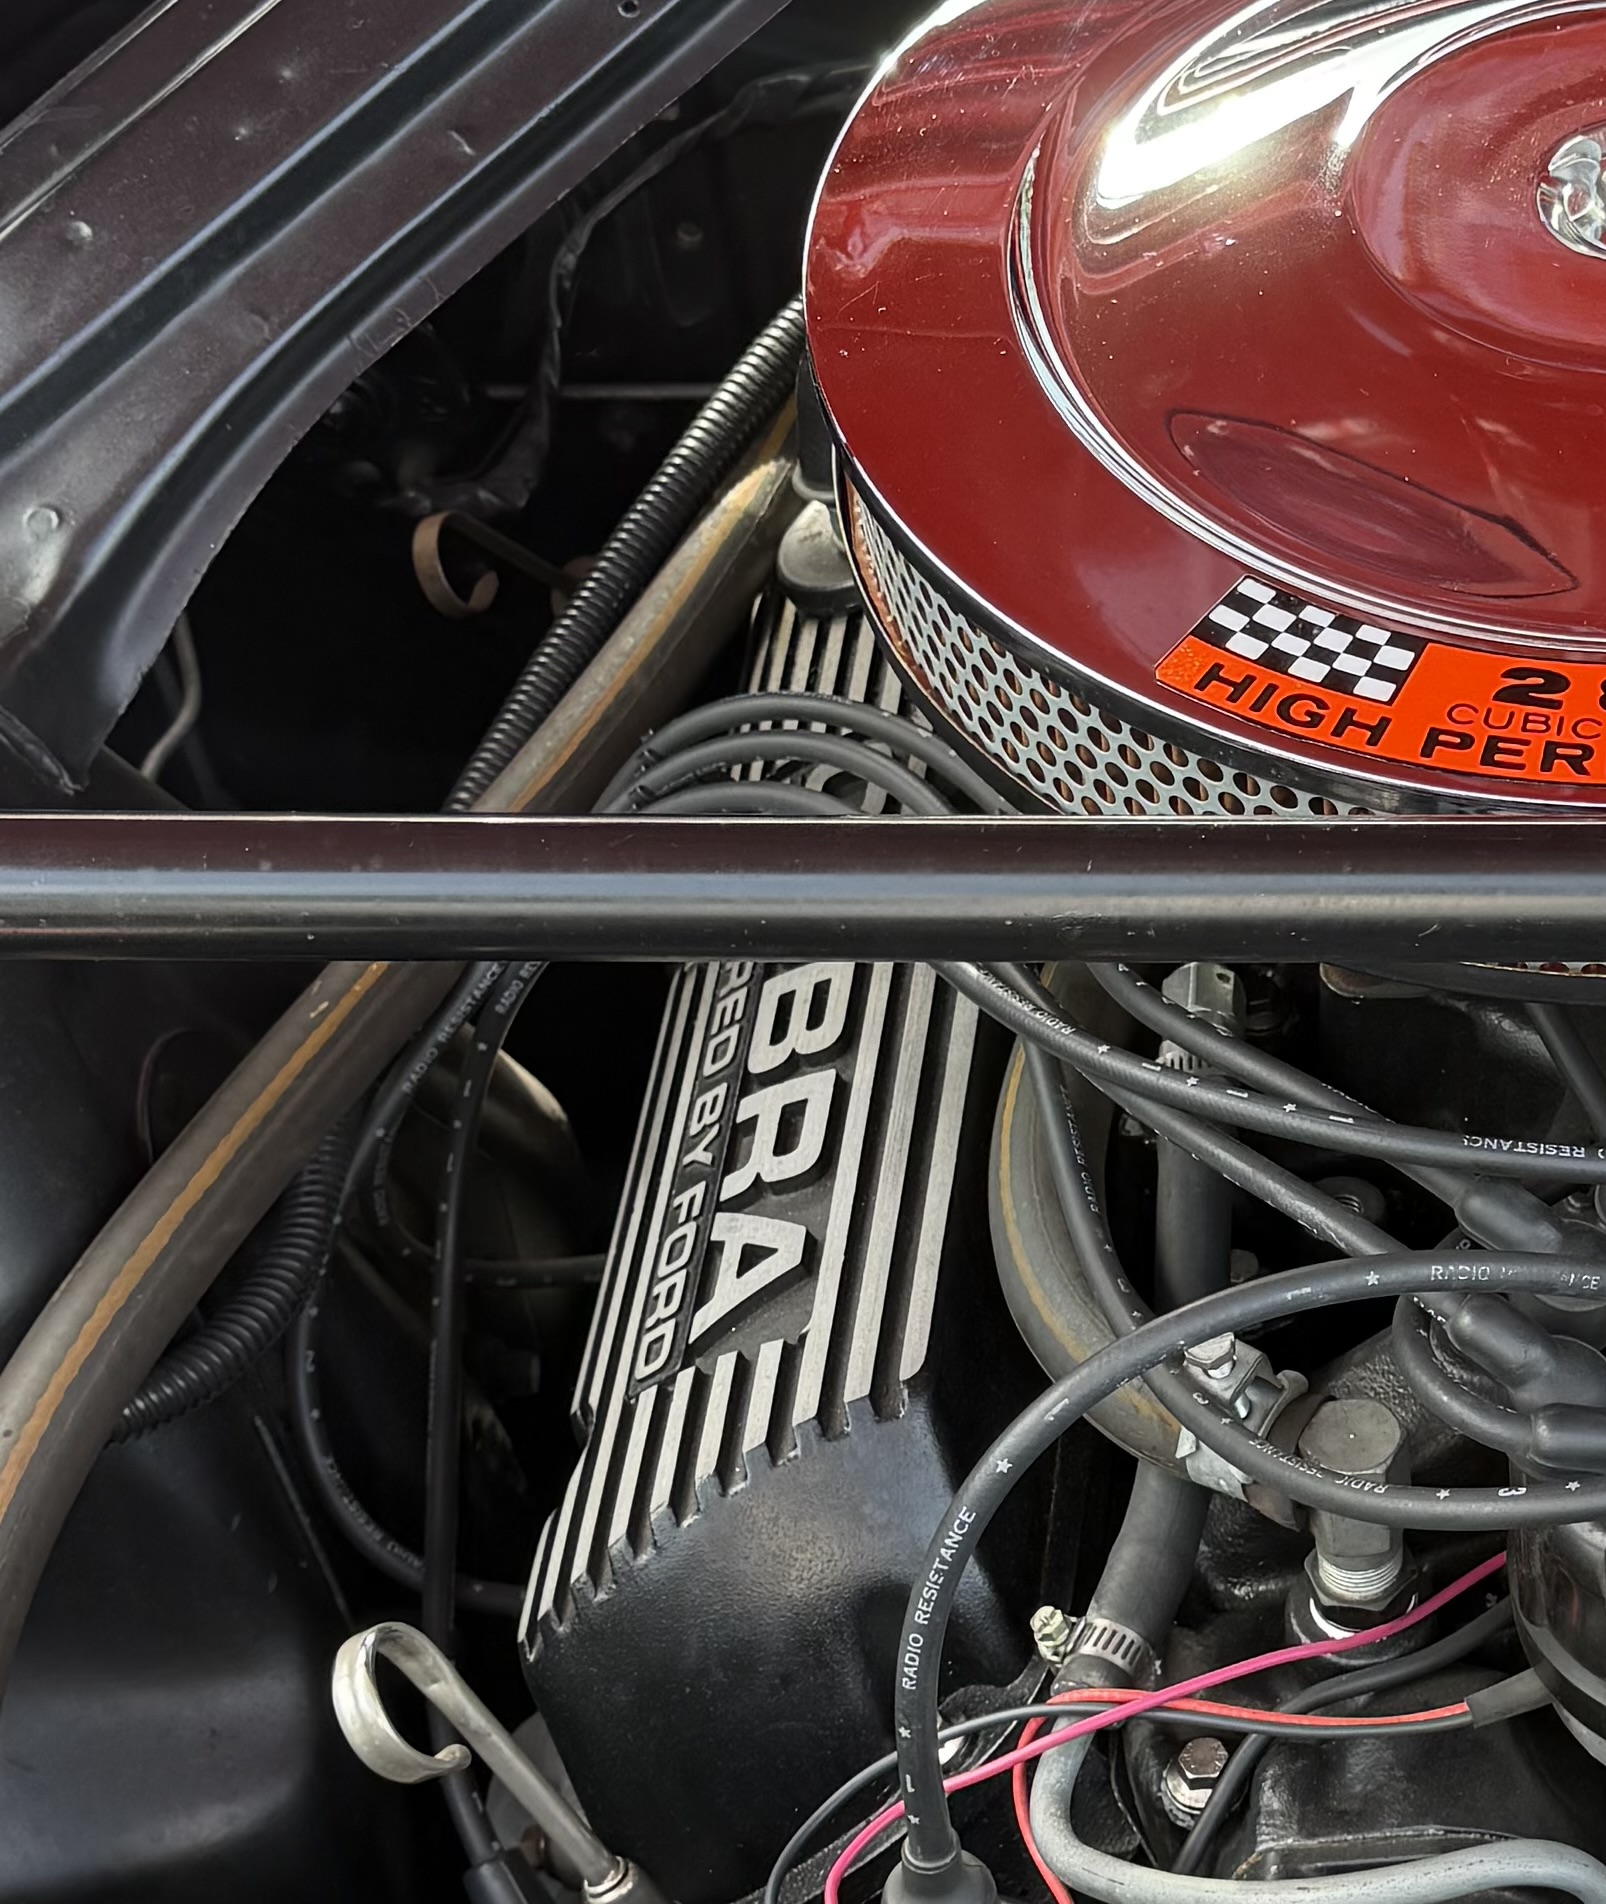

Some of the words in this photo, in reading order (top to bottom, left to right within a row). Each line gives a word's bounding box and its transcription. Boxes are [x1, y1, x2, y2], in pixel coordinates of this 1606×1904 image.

[1193, 661, 1391, 749] HIGH
[1446, 700, 1602, 741] CUBIC
[682, 1087, 729, 1168] BY
[690, 962, 856, 1346] BRA
[634, 1188, 706, 1381] FORD
[902, 1632, 925, 1691] RADIO
[914, 1505, 977, 1626] RESISTANCE
